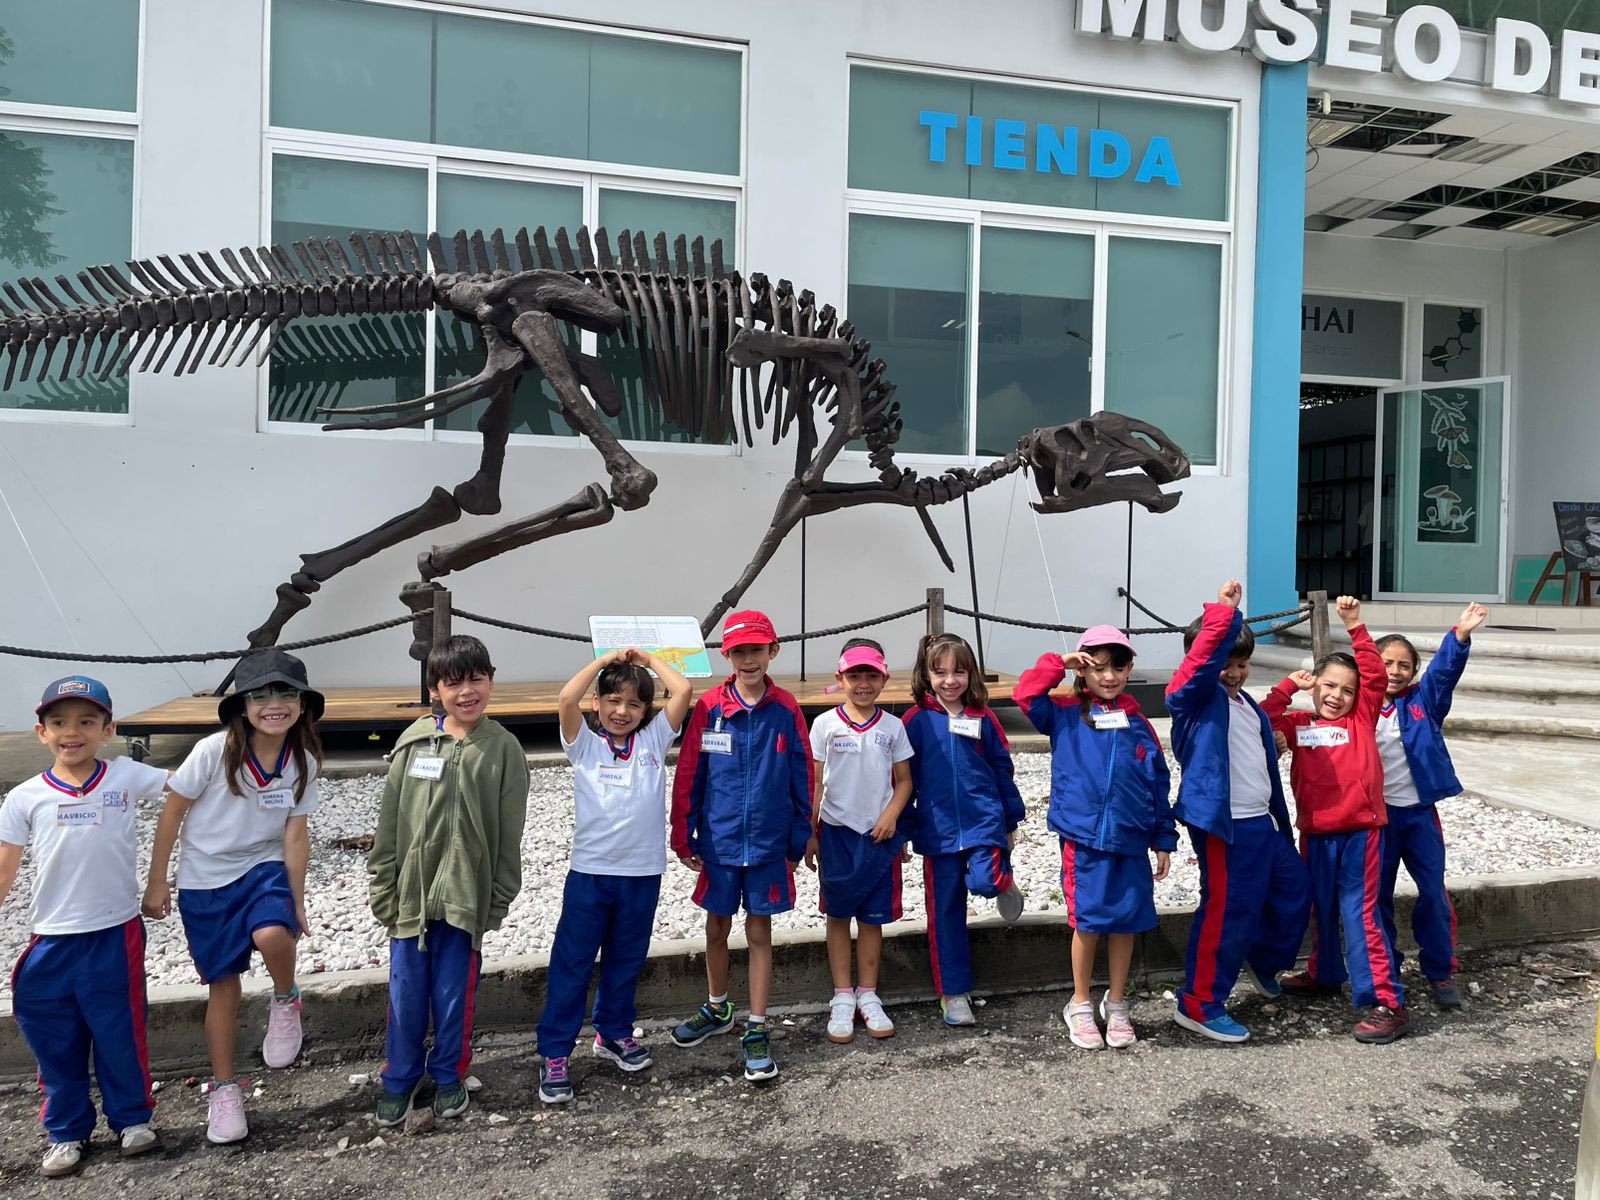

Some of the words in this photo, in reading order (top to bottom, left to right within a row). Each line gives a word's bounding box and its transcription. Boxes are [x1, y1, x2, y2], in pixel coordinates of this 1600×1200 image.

[1079, 0, 1461, 82] MUSEO
[1491, 17, 1600, 103] DE
[919, 111, 1182, 186] TIENDA
[57, 811, 97, 820] MAURICIO
